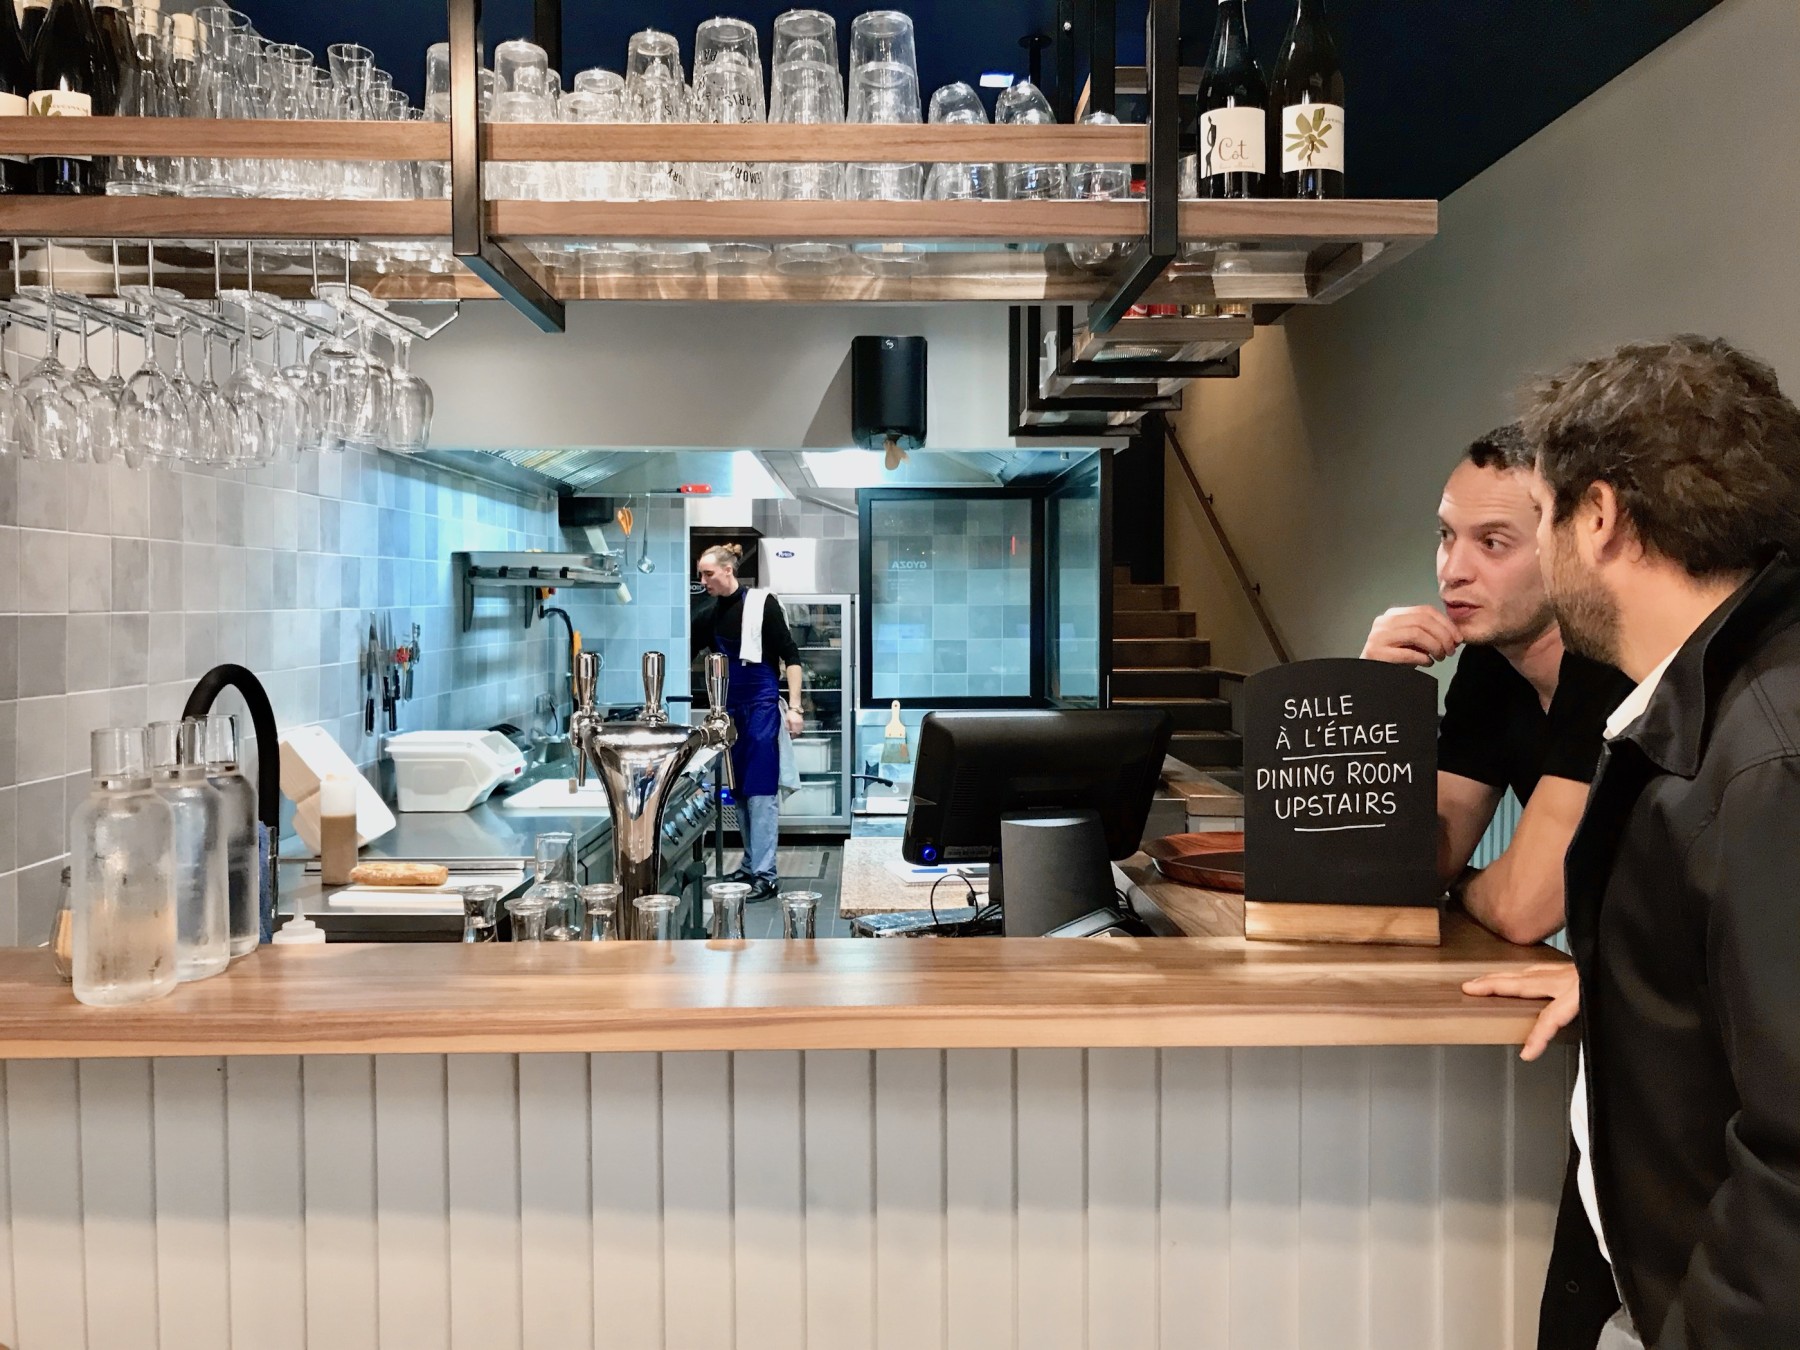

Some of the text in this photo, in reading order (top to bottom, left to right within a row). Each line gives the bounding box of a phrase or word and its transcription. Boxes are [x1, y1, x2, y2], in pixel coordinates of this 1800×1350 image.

[1283, 694, 1354, 720] SALLE
[1275, 720, 1400, 750] À L'ÉTAGE
[1256, 761, 1412, 791] DINING ROOM
[1274, 791, 1397, 820] UPSTAIRS
